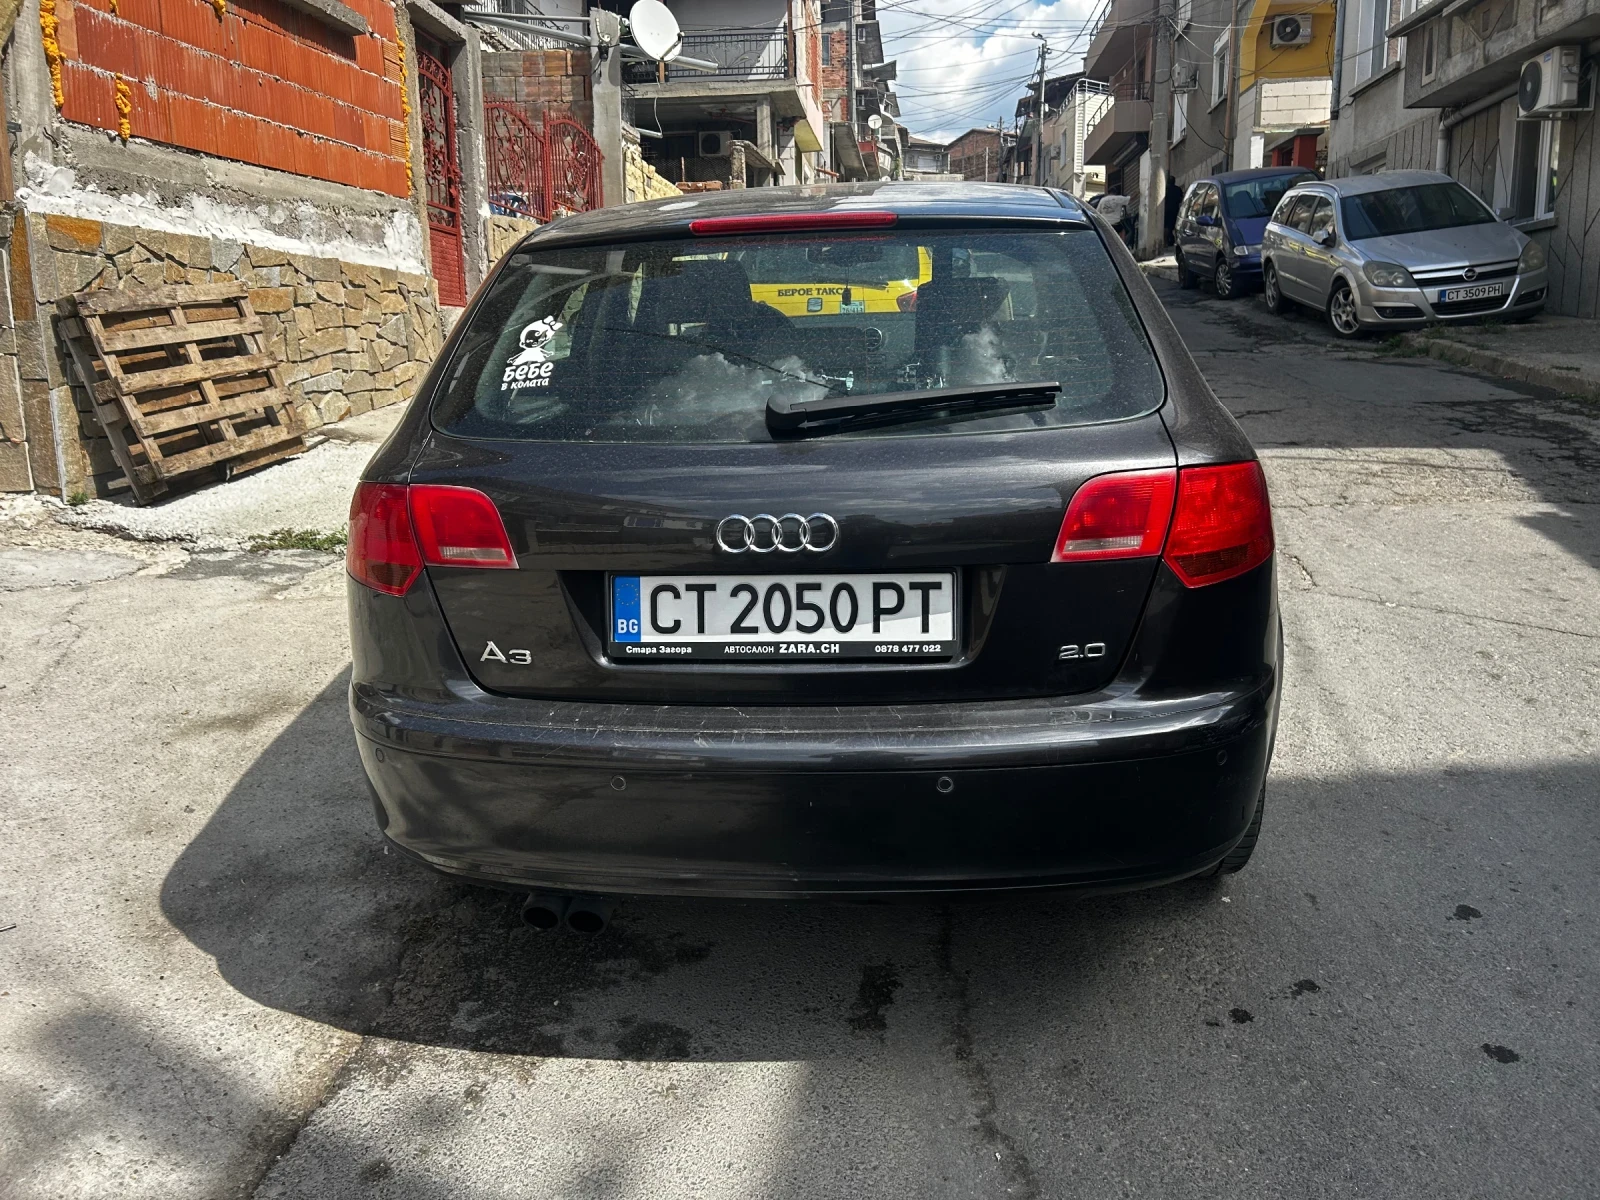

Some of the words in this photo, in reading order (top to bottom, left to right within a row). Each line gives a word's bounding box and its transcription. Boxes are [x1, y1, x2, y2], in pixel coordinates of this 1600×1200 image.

[777, 287, 813, 297] БЕРОЕ
[815, 287, 850, 295] ТАКС
[1448, 291, 1461, 300] CT
[1462, 287, 1486, 299] 3509
[1488, 285, 1500, 295] PH
[650, 583, 717, 635] CT
[730, 582, 859, 635] 2050
[872, 581, 942, 634] PT
[617, 618, 639, 634] BG
[480, 640, 532, 665] A3
[724, 645, 774, 655] АВТОСАЛОН
[779, 643, 840, 654] ZARA.CH
[874, 645, 900, 653] 0878
[901, 645, 920, 653] 477
[922, 644, 942, 653] 022
[1059, 642, 1106, 660] 2.0
